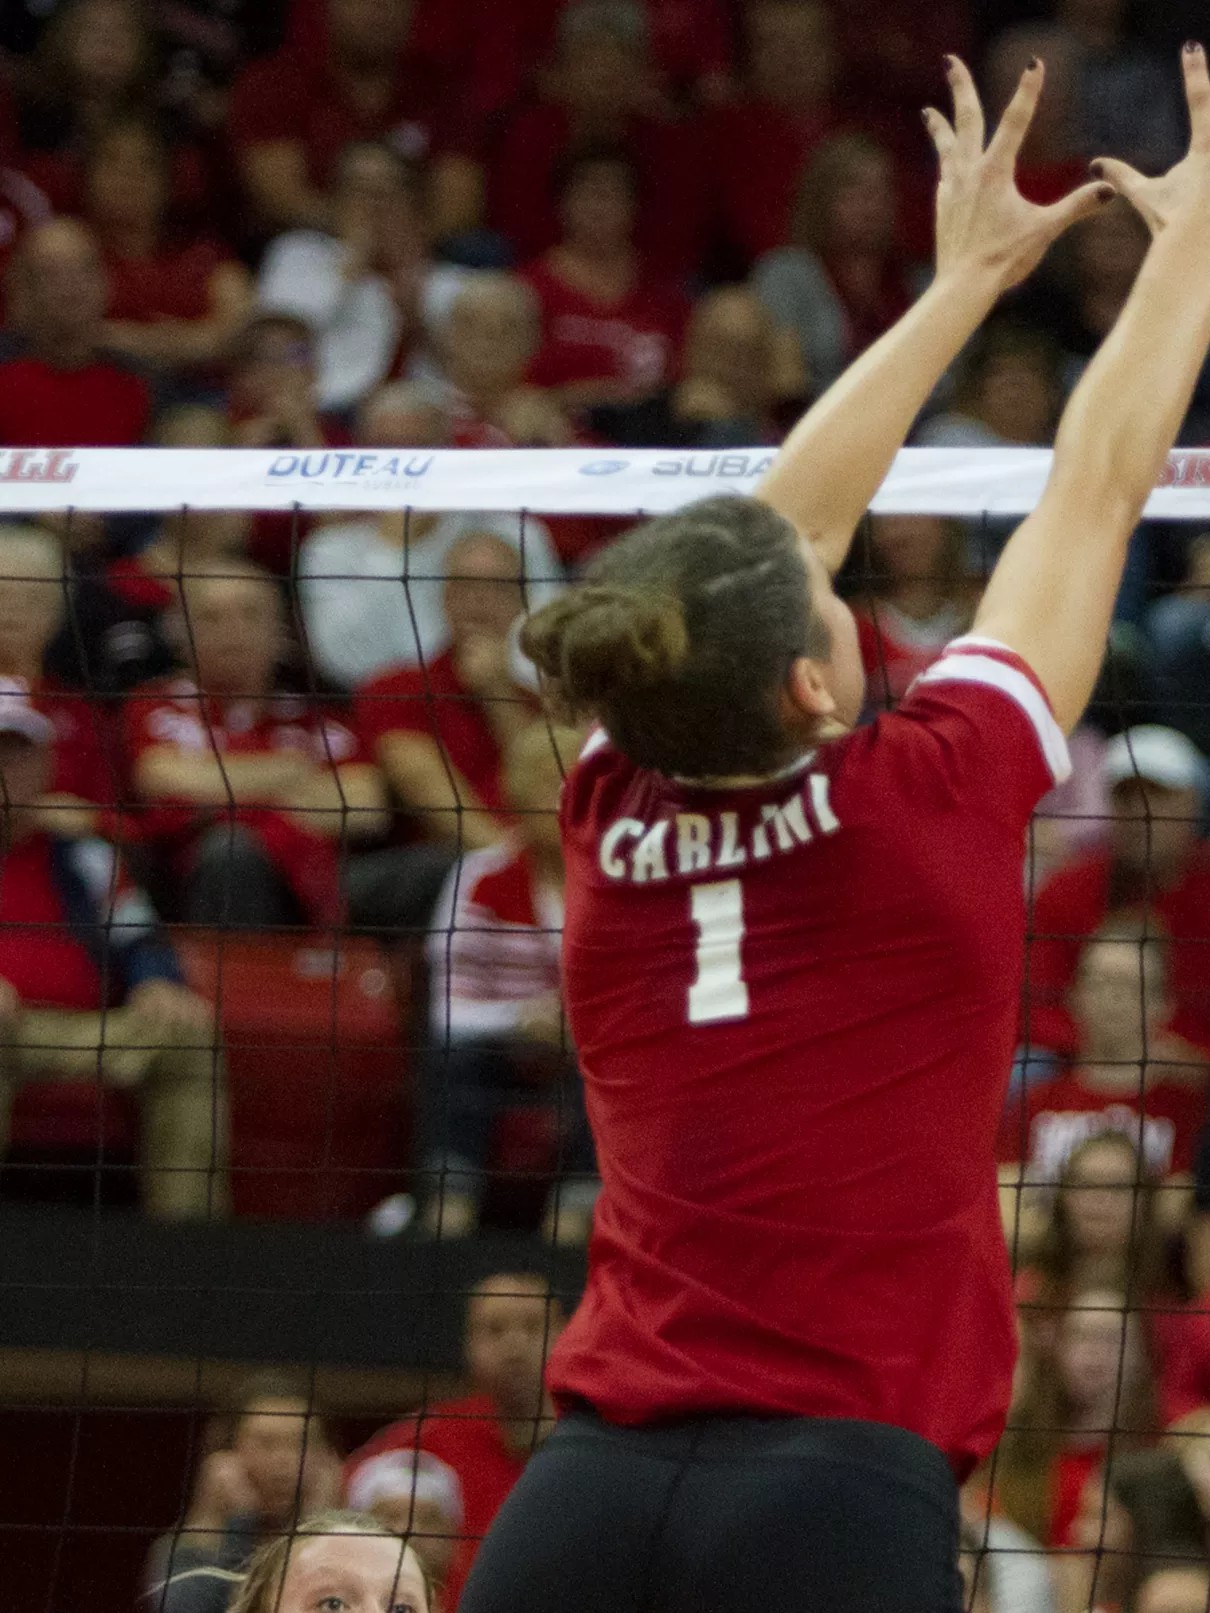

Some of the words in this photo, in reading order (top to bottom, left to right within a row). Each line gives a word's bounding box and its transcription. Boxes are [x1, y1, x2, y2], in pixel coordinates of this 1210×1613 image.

[0, 449, 80, 484] LL
[267, 453, 436, 478] DUTEAU
[688, 878, 749, 1023] 1
